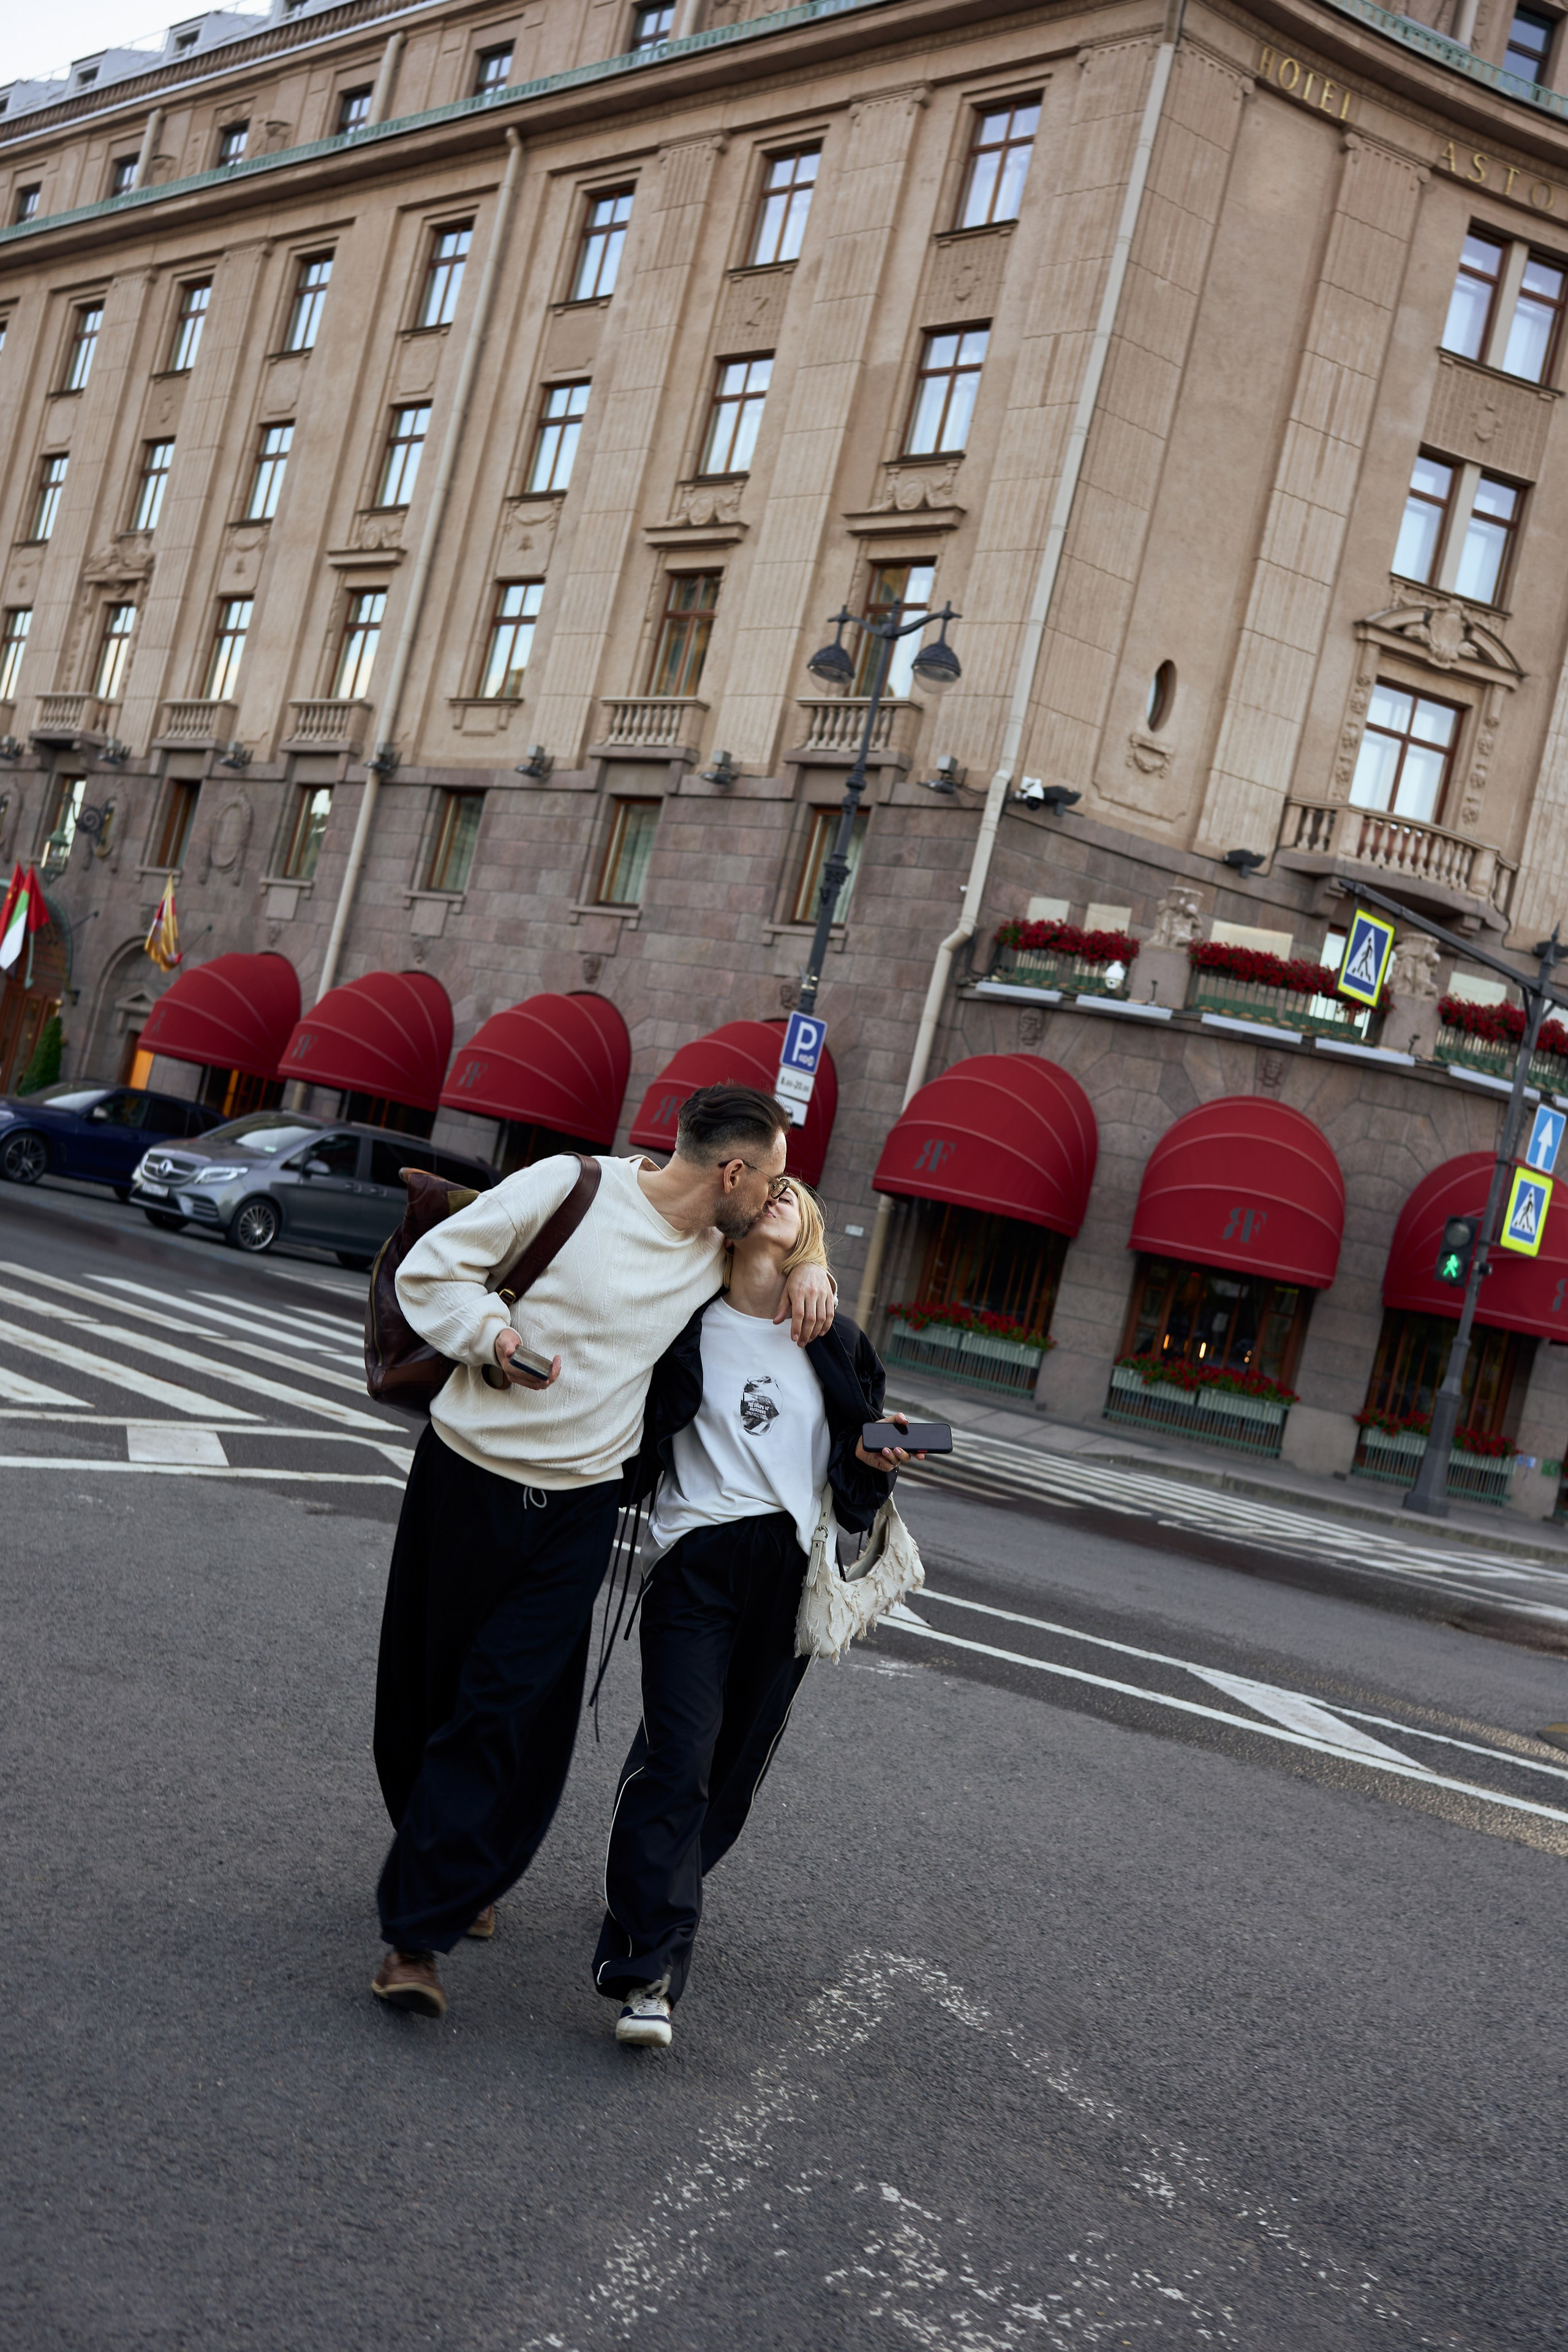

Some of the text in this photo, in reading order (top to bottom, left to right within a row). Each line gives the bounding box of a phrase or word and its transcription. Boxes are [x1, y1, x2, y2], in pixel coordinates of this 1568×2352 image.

[1259, 45, 1556, 211] HOTEL ASTO
[792, 1020, 818, 1063] P
